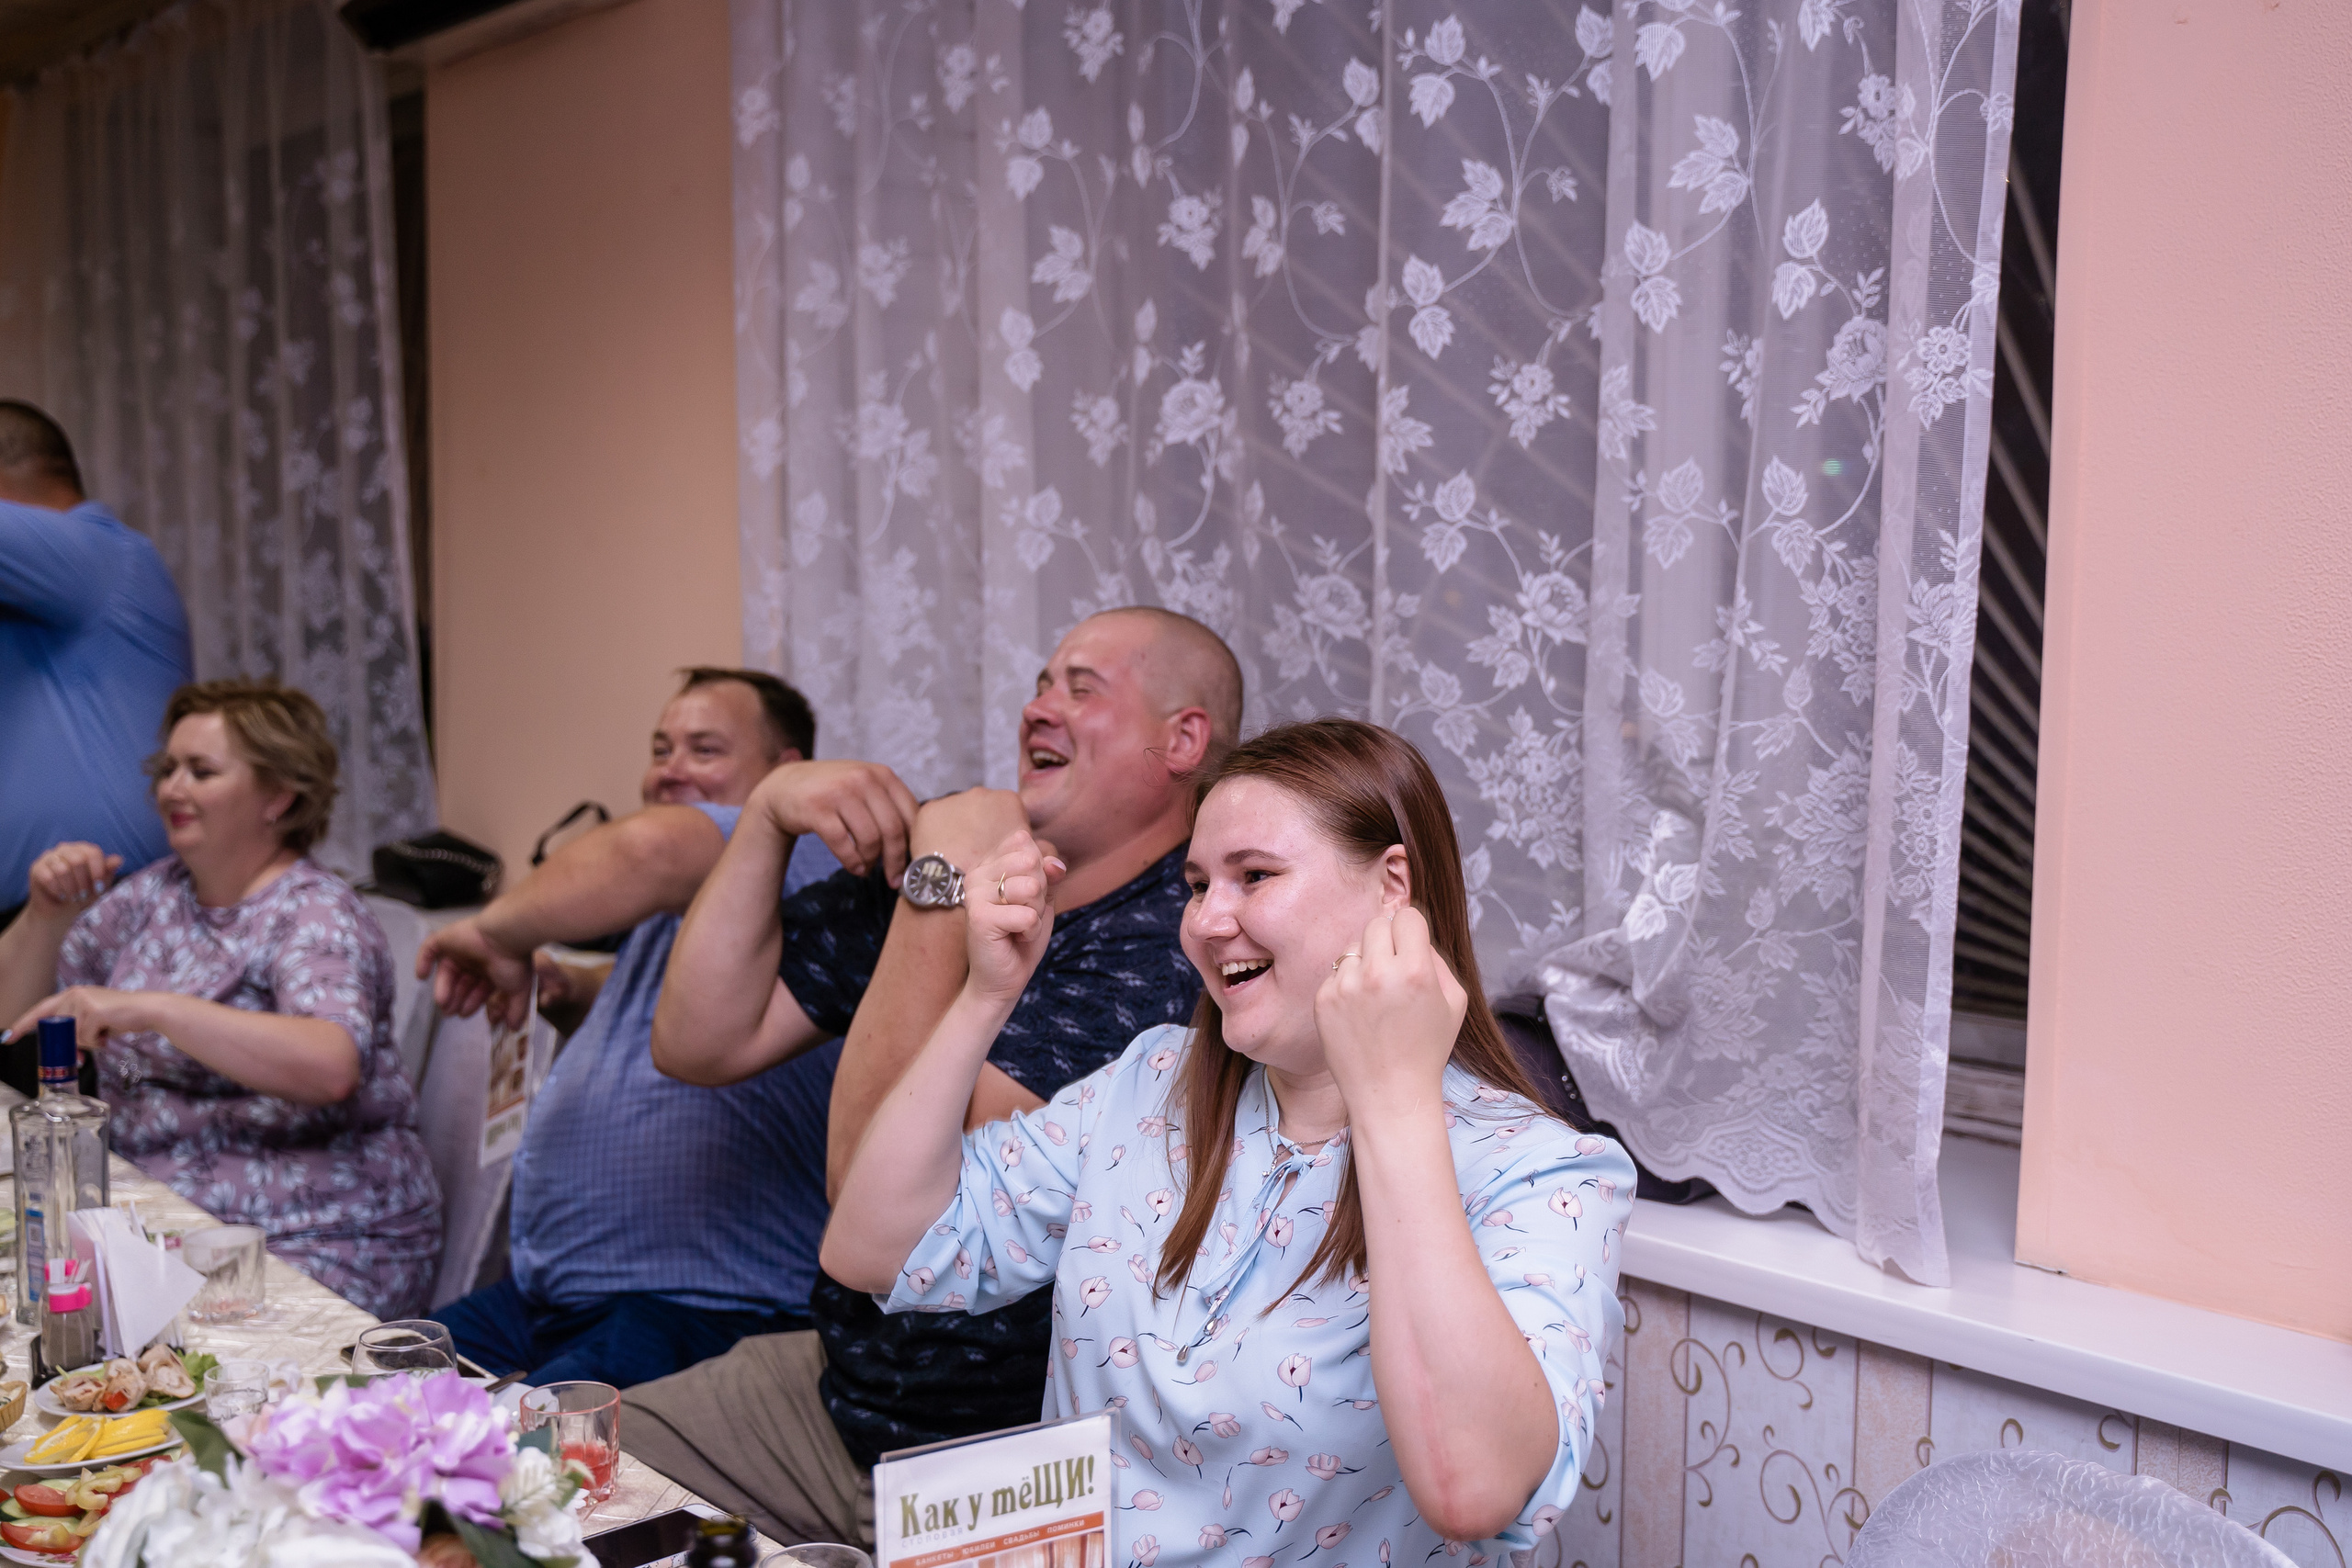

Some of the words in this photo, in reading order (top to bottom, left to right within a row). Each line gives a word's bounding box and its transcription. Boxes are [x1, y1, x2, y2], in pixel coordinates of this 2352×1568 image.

[899, 1492, 959, 1539] Как
[967, 1492, 983, 1531] у
[915, 1551, 954, 1566] БАНКЕТЫ
[962, 1540, 996, 1555] ЮБИЛЕИ
[1003, 1529, 1040, 1545] СВАДЬБЫ
[1047, 1518, 1085, 1533] ПОМИНКИ
